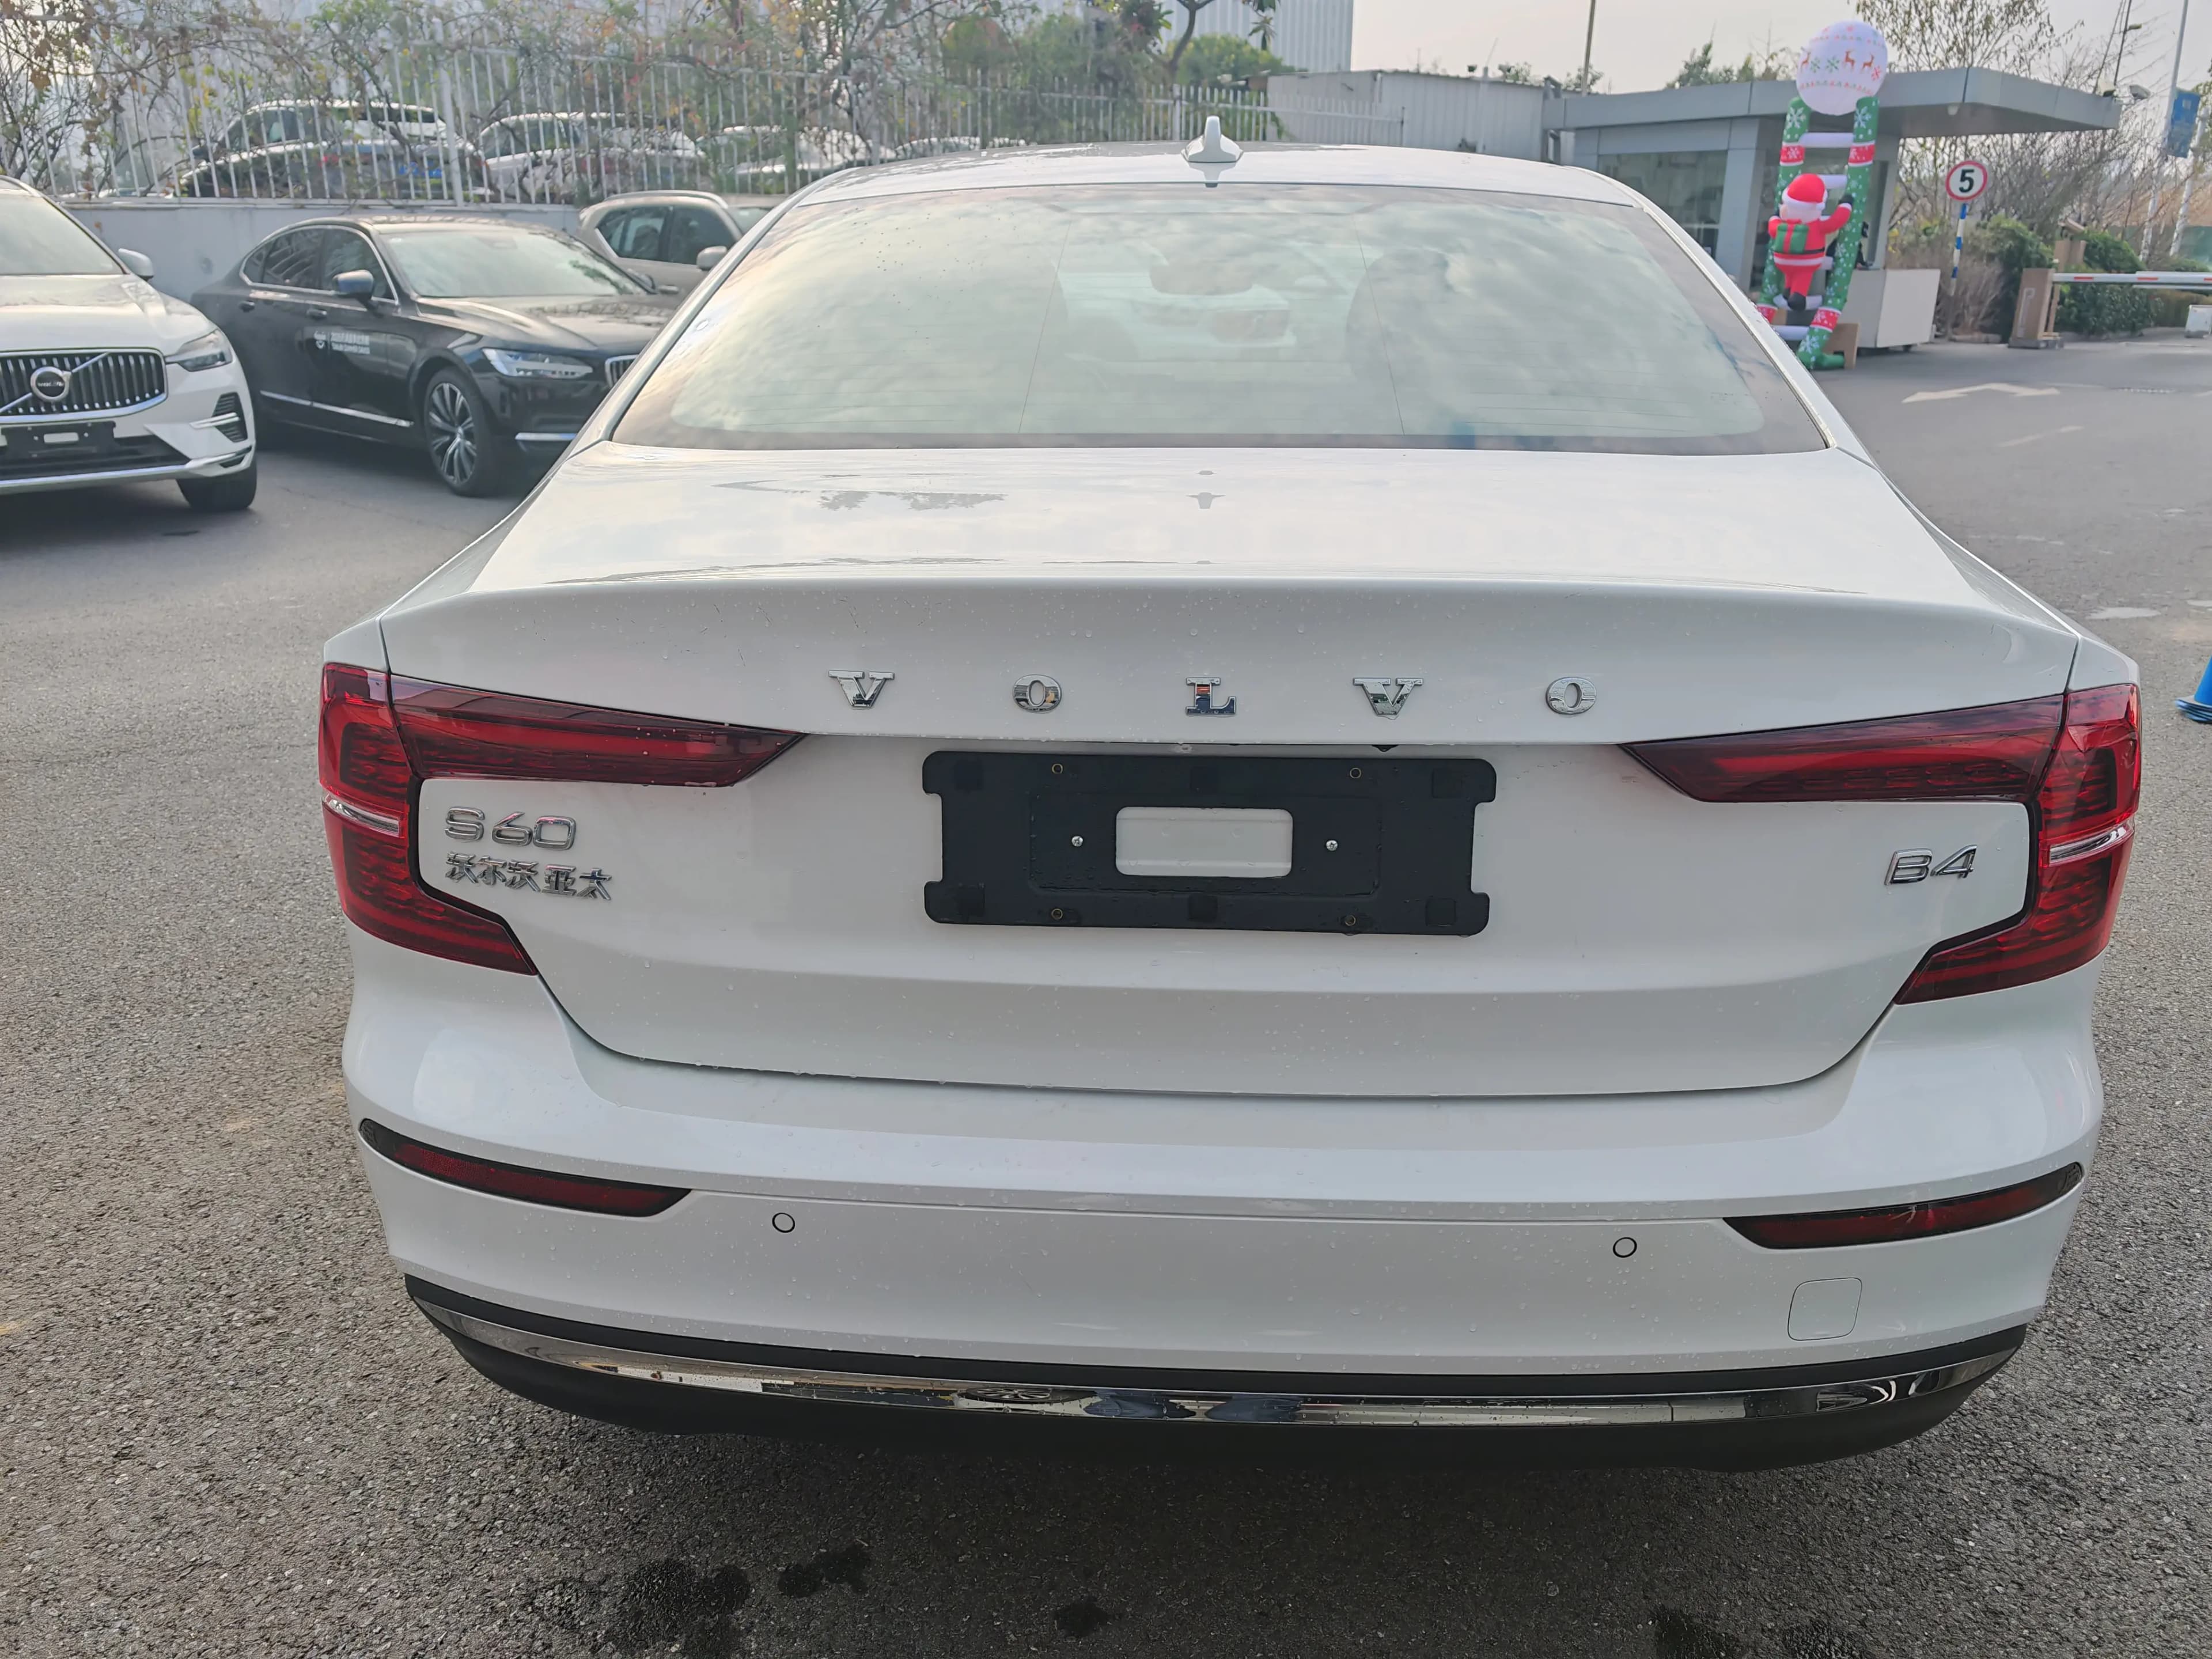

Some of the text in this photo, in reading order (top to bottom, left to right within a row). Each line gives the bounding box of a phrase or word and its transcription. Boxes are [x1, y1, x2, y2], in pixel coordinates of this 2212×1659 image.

[1959, 169, 1974, 192] 5
[828, 669, 1596, 716] VOLVO
[444, 806, 576, 850] S60
[1884, 844, 1977, 885] B4
